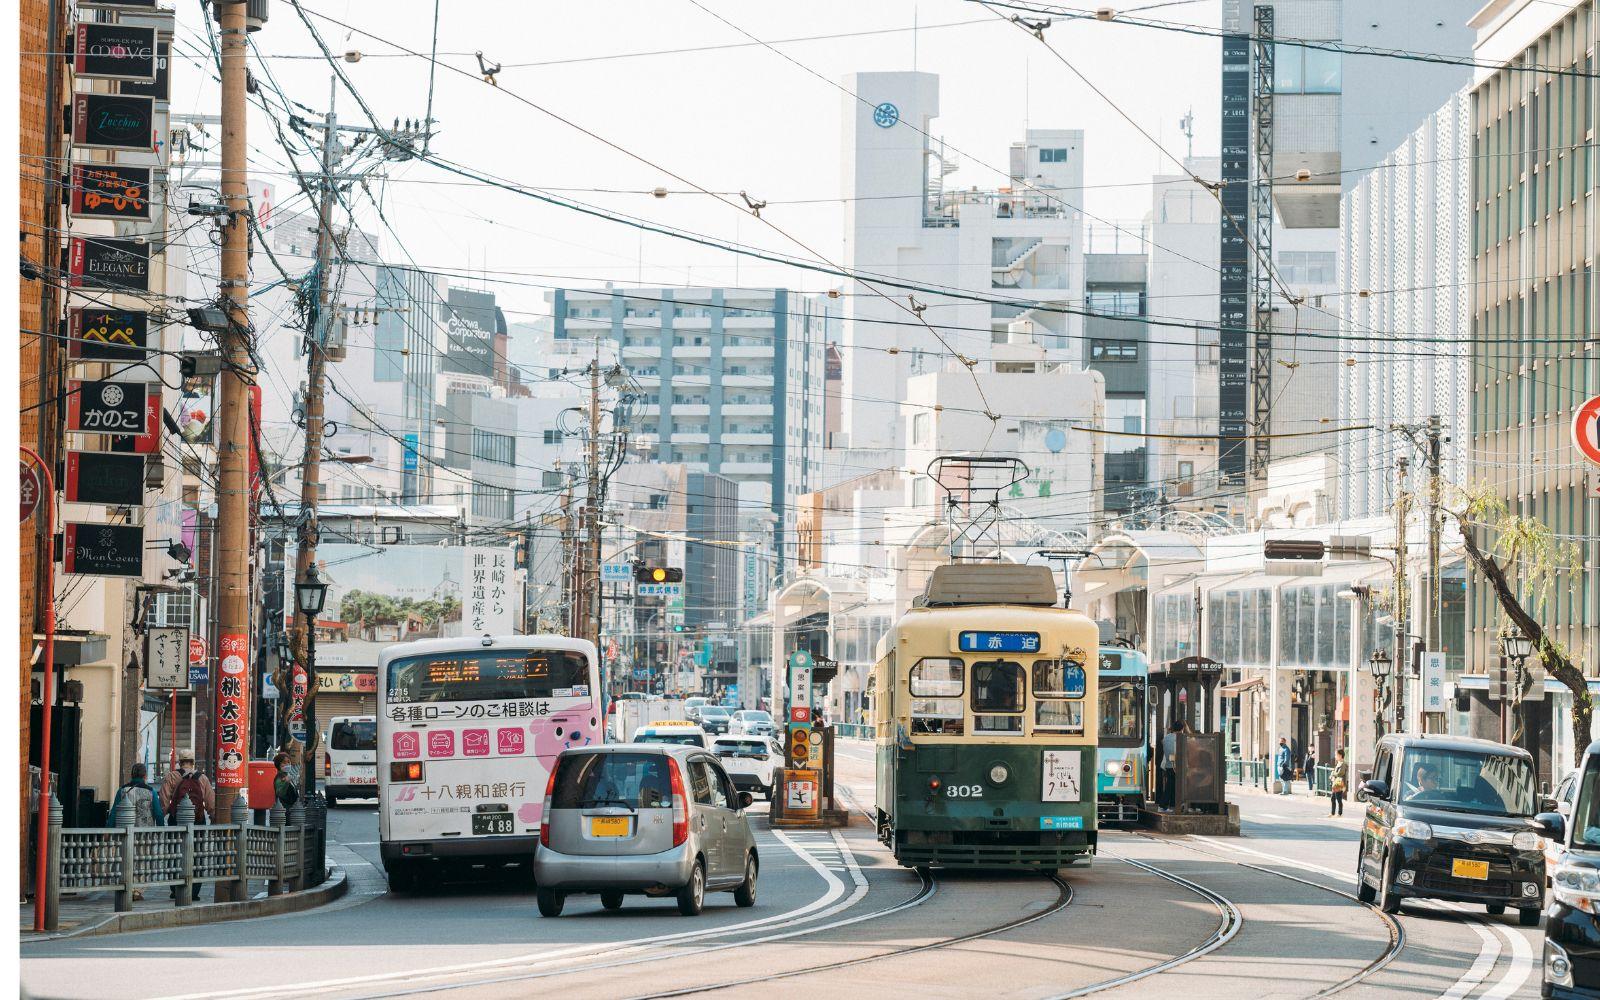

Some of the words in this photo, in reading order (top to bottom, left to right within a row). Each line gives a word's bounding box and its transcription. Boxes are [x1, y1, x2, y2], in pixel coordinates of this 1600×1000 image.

[89, 259, 145, 275] ELEGANCE
[83, 408, 139, 428] かのこ
[471, 553, 487, 631] 世界遺産を
[491, 553, 506, 616] 長崎から
[964, 633, 977, 649] 1
[988, 636, 1040, 650] 赤迫
[1430, 657, 1440, 706] 思案橋
[389, 687, 408, 697] 2715
[221, 675, 242, 744] 桃太呂
[391, 700, 551, 722] 各種ローンのご相談は
[420, 782, 526, 800] 十八親和銀行
[791, 782, 810, 790] 注意
[946, 785, 983, 798] 302
[1055, 821, 1080, 830] nimoca
